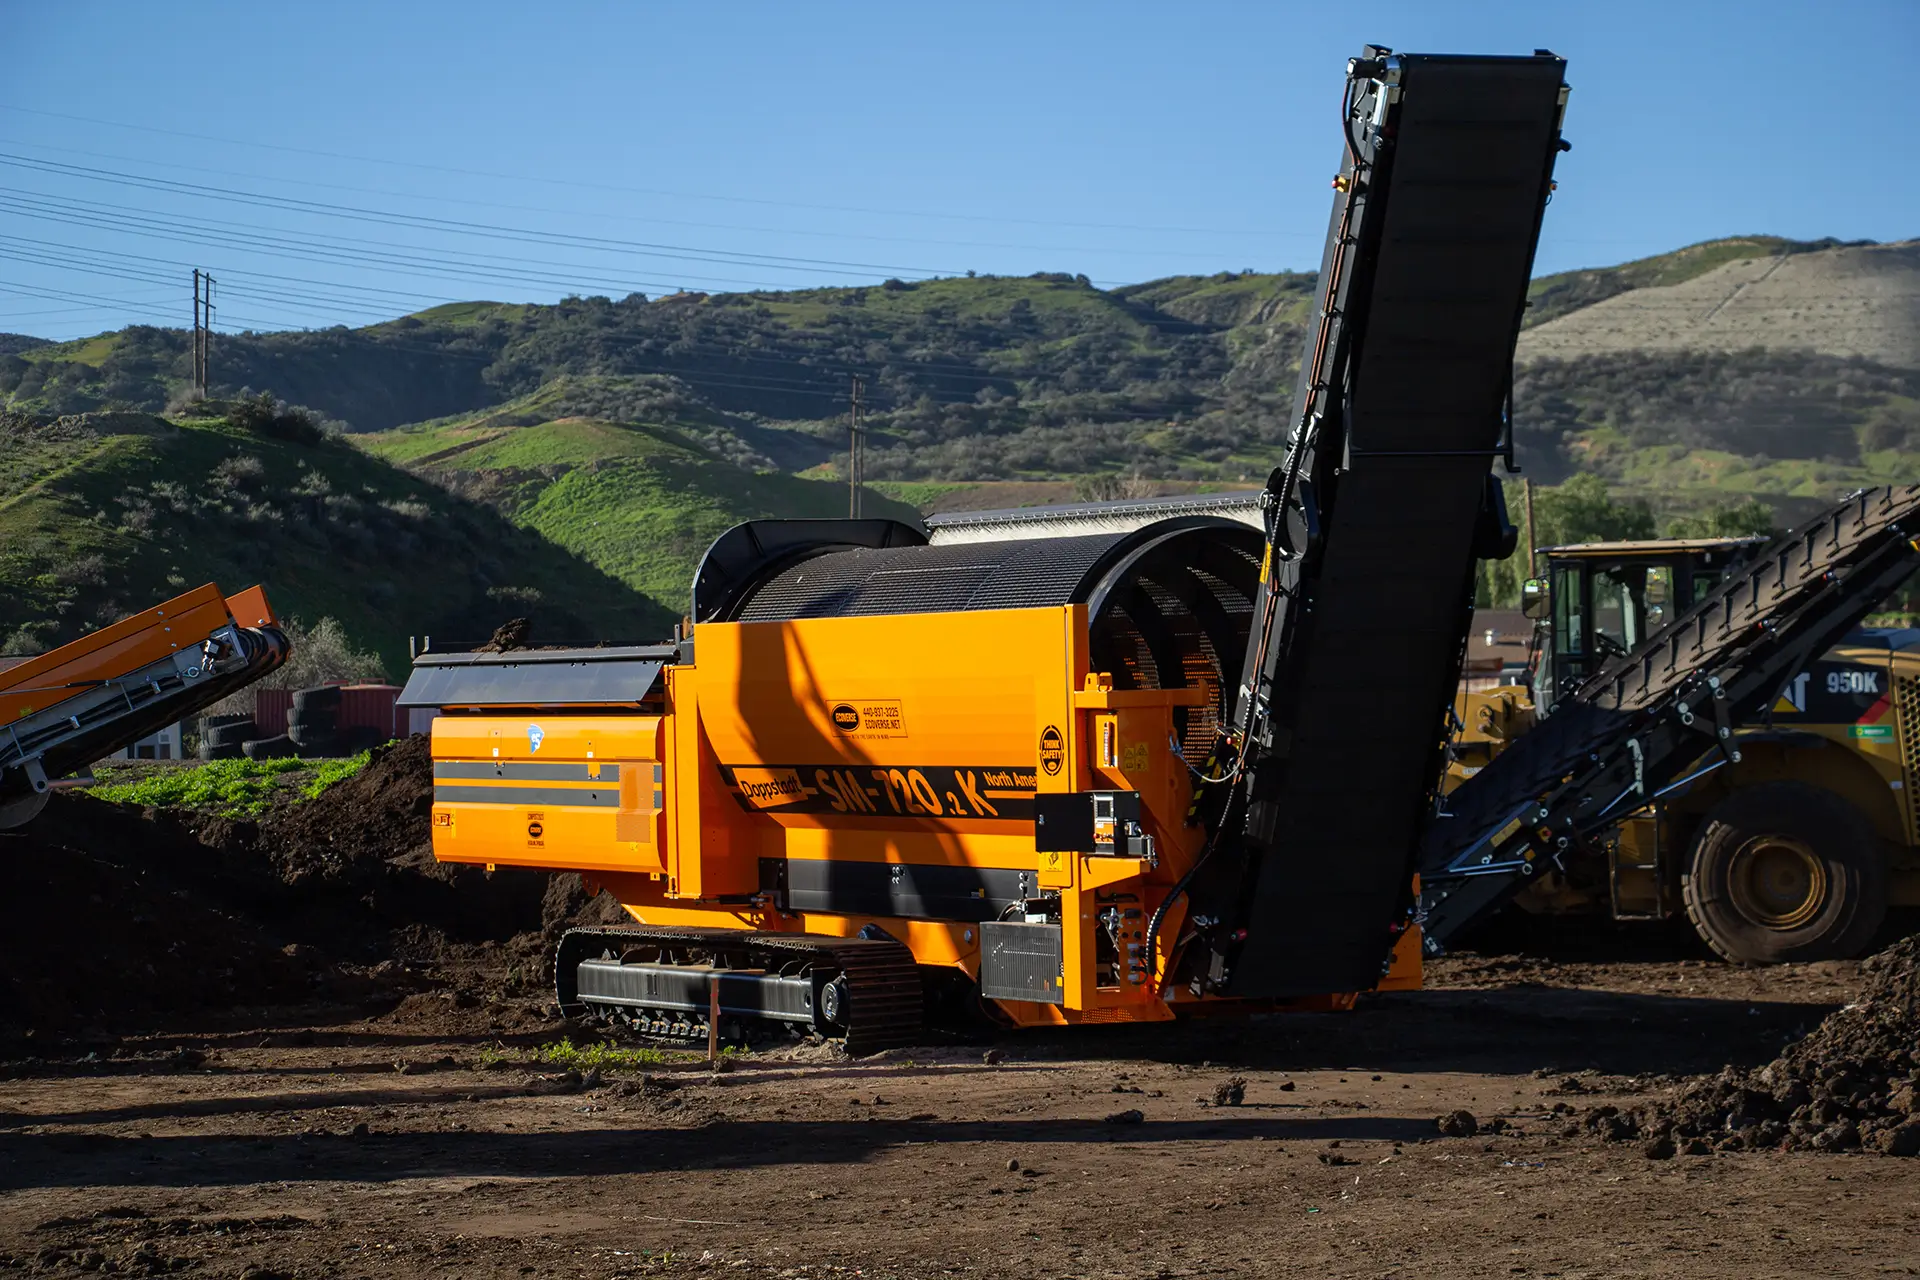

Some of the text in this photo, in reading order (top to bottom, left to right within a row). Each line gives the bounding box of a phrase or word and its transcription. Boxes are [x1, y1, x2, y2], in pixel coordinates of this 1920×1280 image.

[1827, 672, 1878, 693] 950K
[863, 707, 899, 717] 440-937-3225
[835, 712, 857, 723] ECOVERSE
[864, 719, 901, 729] ECOVERSE.NET
[1043, 739, 1060, 749] THINK
[1042, 749, 1061, 759] SAFETY
[982, 771, 1014, 787] North
[741, 775, 802, 800] Doppstadt
